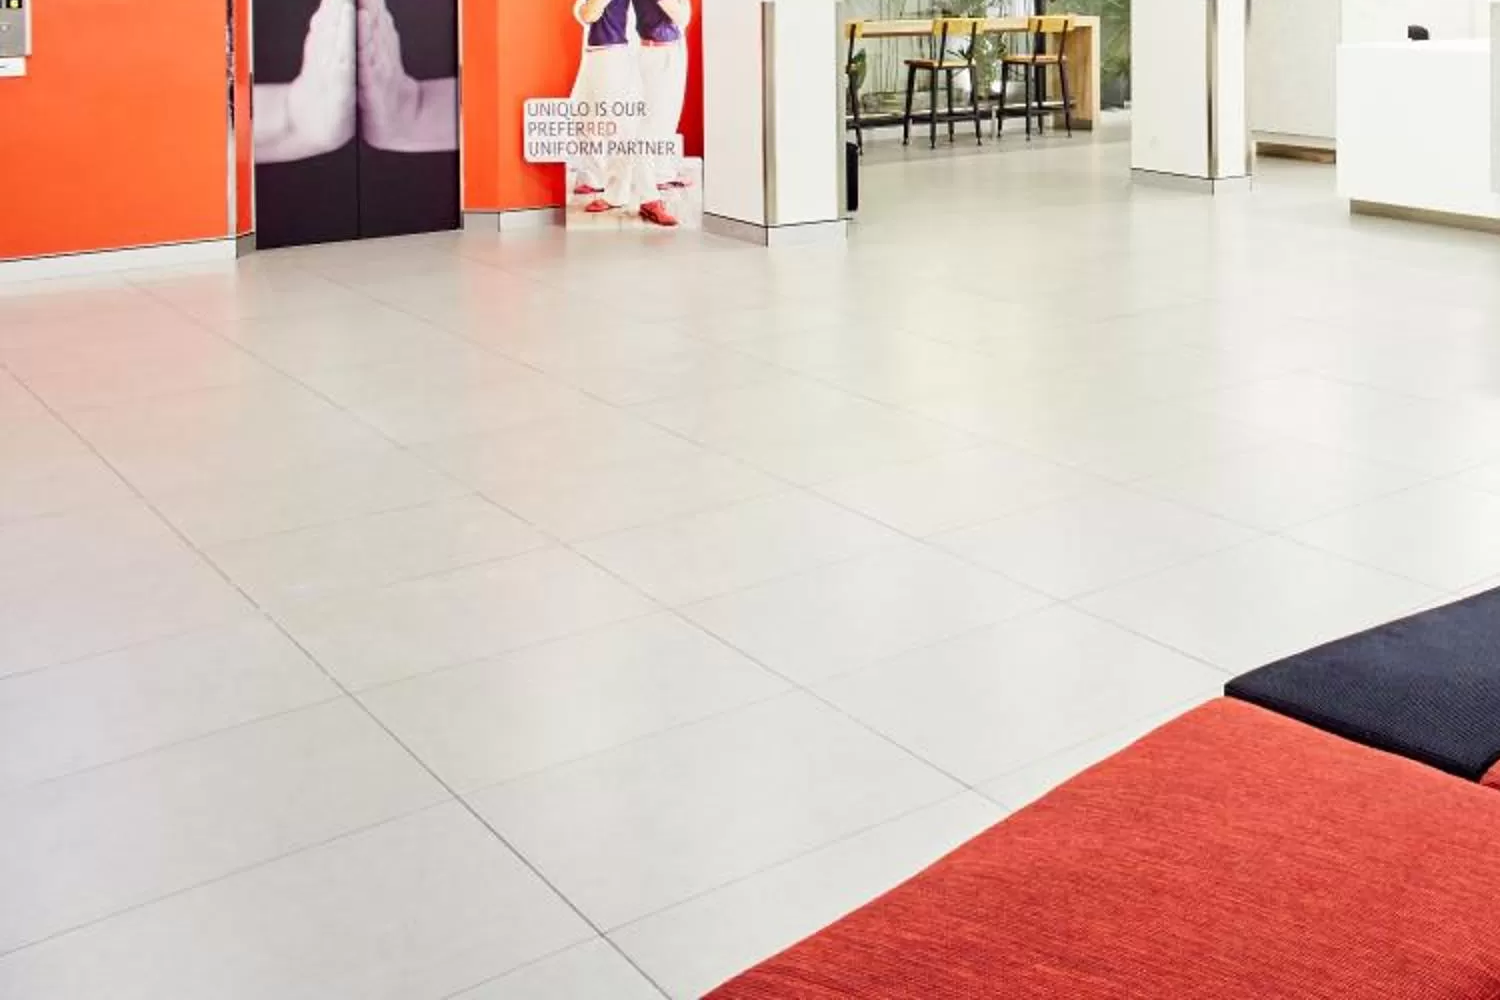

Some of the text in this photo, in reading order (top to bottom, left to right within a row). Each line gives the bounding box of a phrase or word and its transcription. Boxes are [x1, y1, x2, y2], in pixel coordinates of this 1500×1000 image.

[527, 101, 647, 120] UNIQLO IS OUR
[527, 121, 617, 137] PREFERRED
[528, 140, 676, 156] UNIFORM PARTNER
